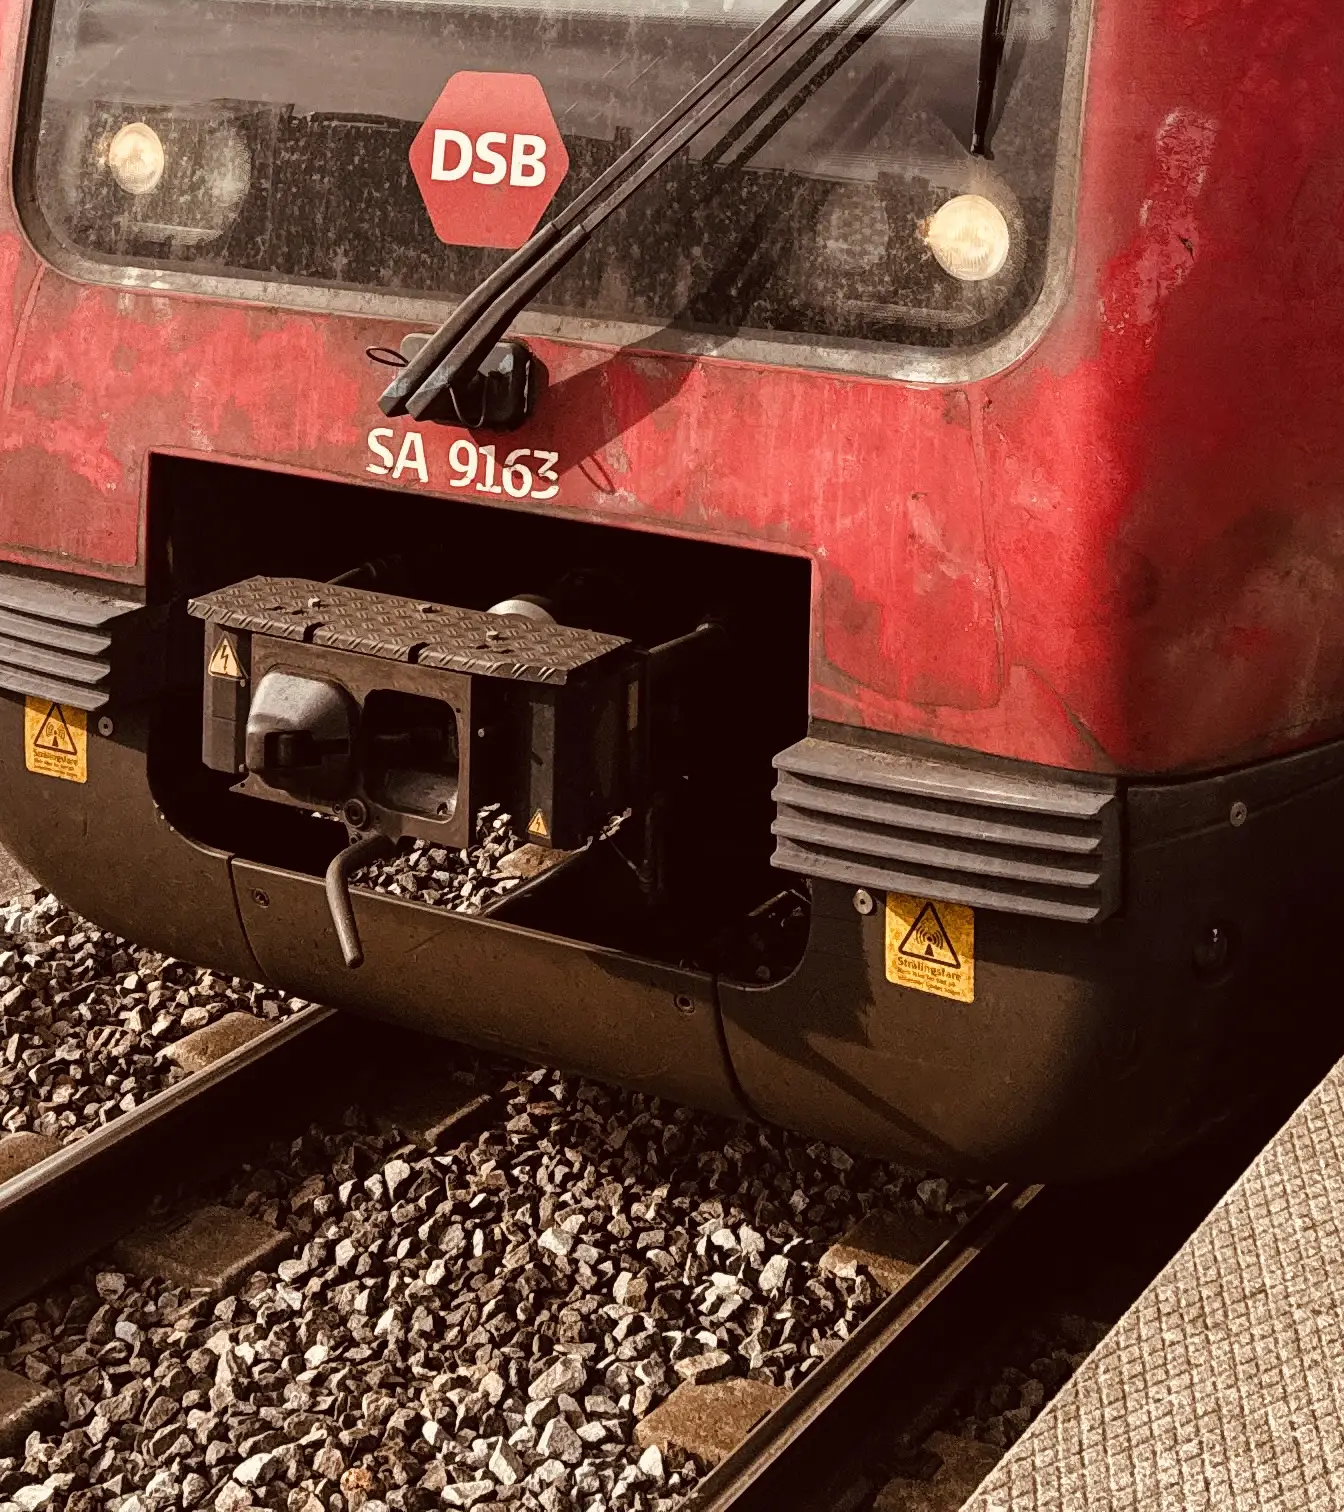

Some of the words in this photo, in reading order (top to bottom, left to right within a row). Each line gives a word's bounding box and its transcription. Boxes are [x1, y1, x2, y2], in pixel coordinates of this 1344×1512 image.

[429, 129, 548, 188] DSB
[365, 427, 429, 484] SA
[448, 439, 560, 500] 9163
